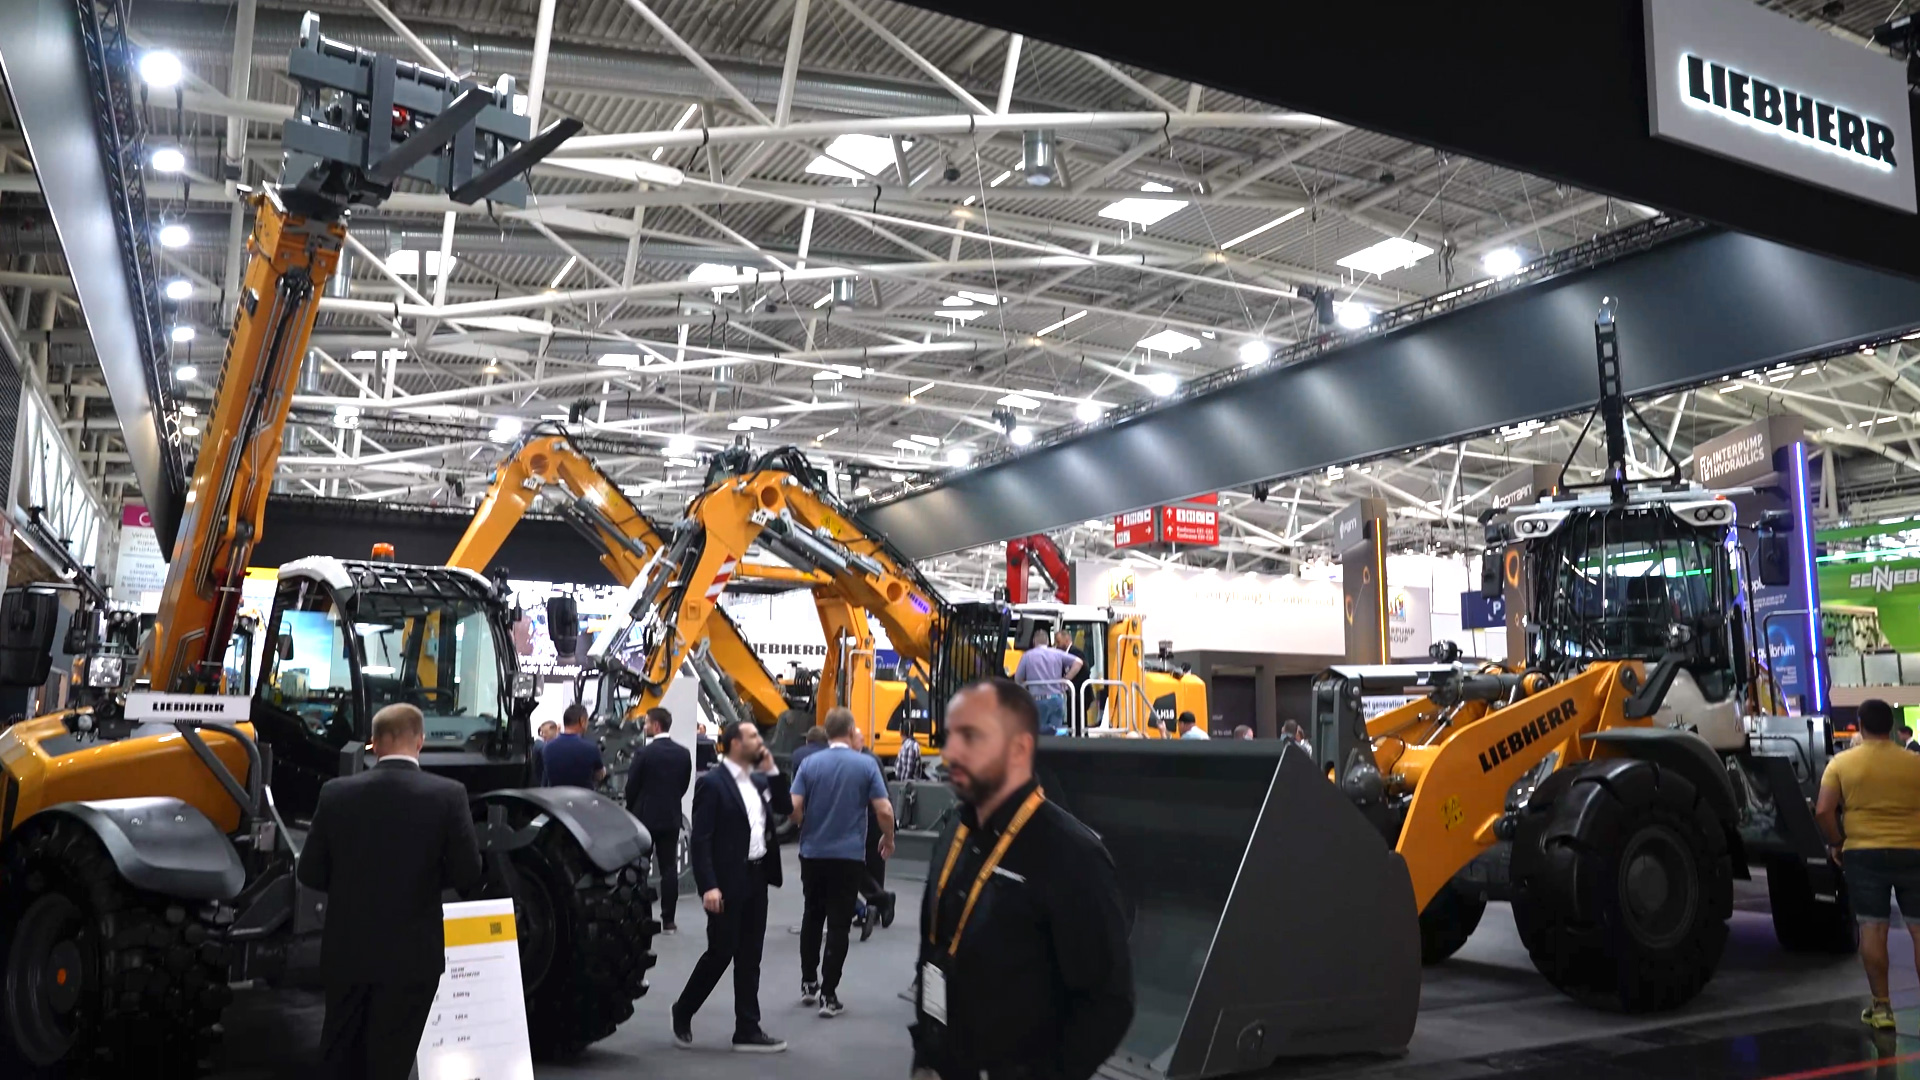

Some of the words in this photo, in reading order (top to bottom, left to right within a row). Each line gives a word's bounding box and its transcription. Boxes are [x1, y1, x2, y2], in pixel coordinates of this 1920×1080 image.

[1685, 54, 1897, 168] LIEBHERR
[1712, 432, 1763, 465] INTERPUMP
[1713, 446, 1765, 478] HYDRAULICS
[1850, 564, 1920, 593] SENNEB
[1492, 600, 1502, 615] P
[1391, 627, 1415, 636] RPUMP
[753, 642, 827, 656] IEBHERR
[152, 701, 225, 712] LIEBHERR
[1478, 698, 1578, 774] LIEBHERR
